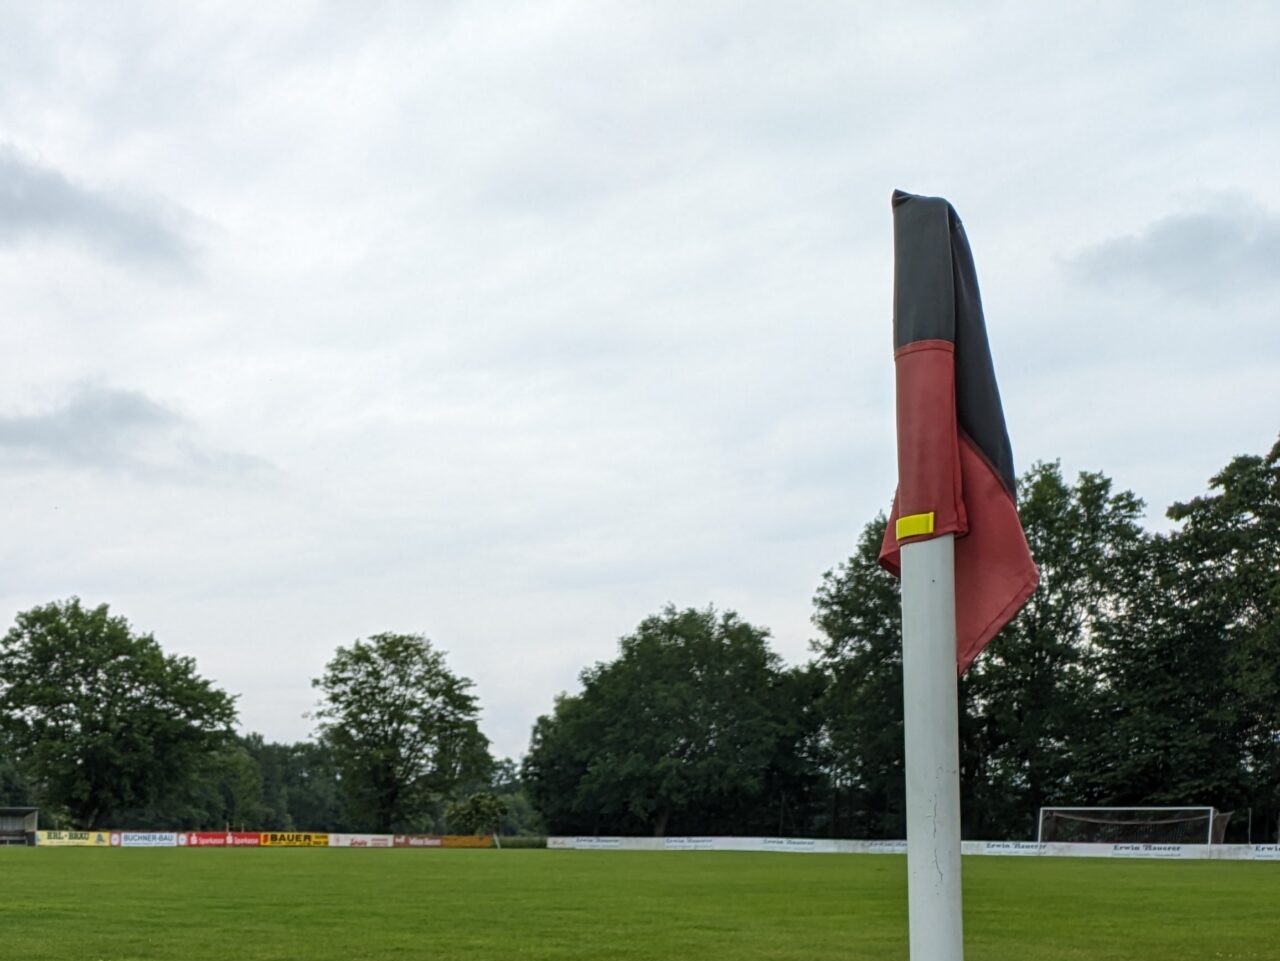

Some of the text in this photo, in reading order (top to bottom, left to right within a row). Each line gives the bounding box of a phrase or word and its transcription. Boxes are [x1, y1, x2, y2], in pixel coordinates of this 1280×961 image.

[198, 836, 225, 844] Sparkasse
[234, 836, 259, 844] Sparkasse
[271, 833, 311, 842] BAUER
